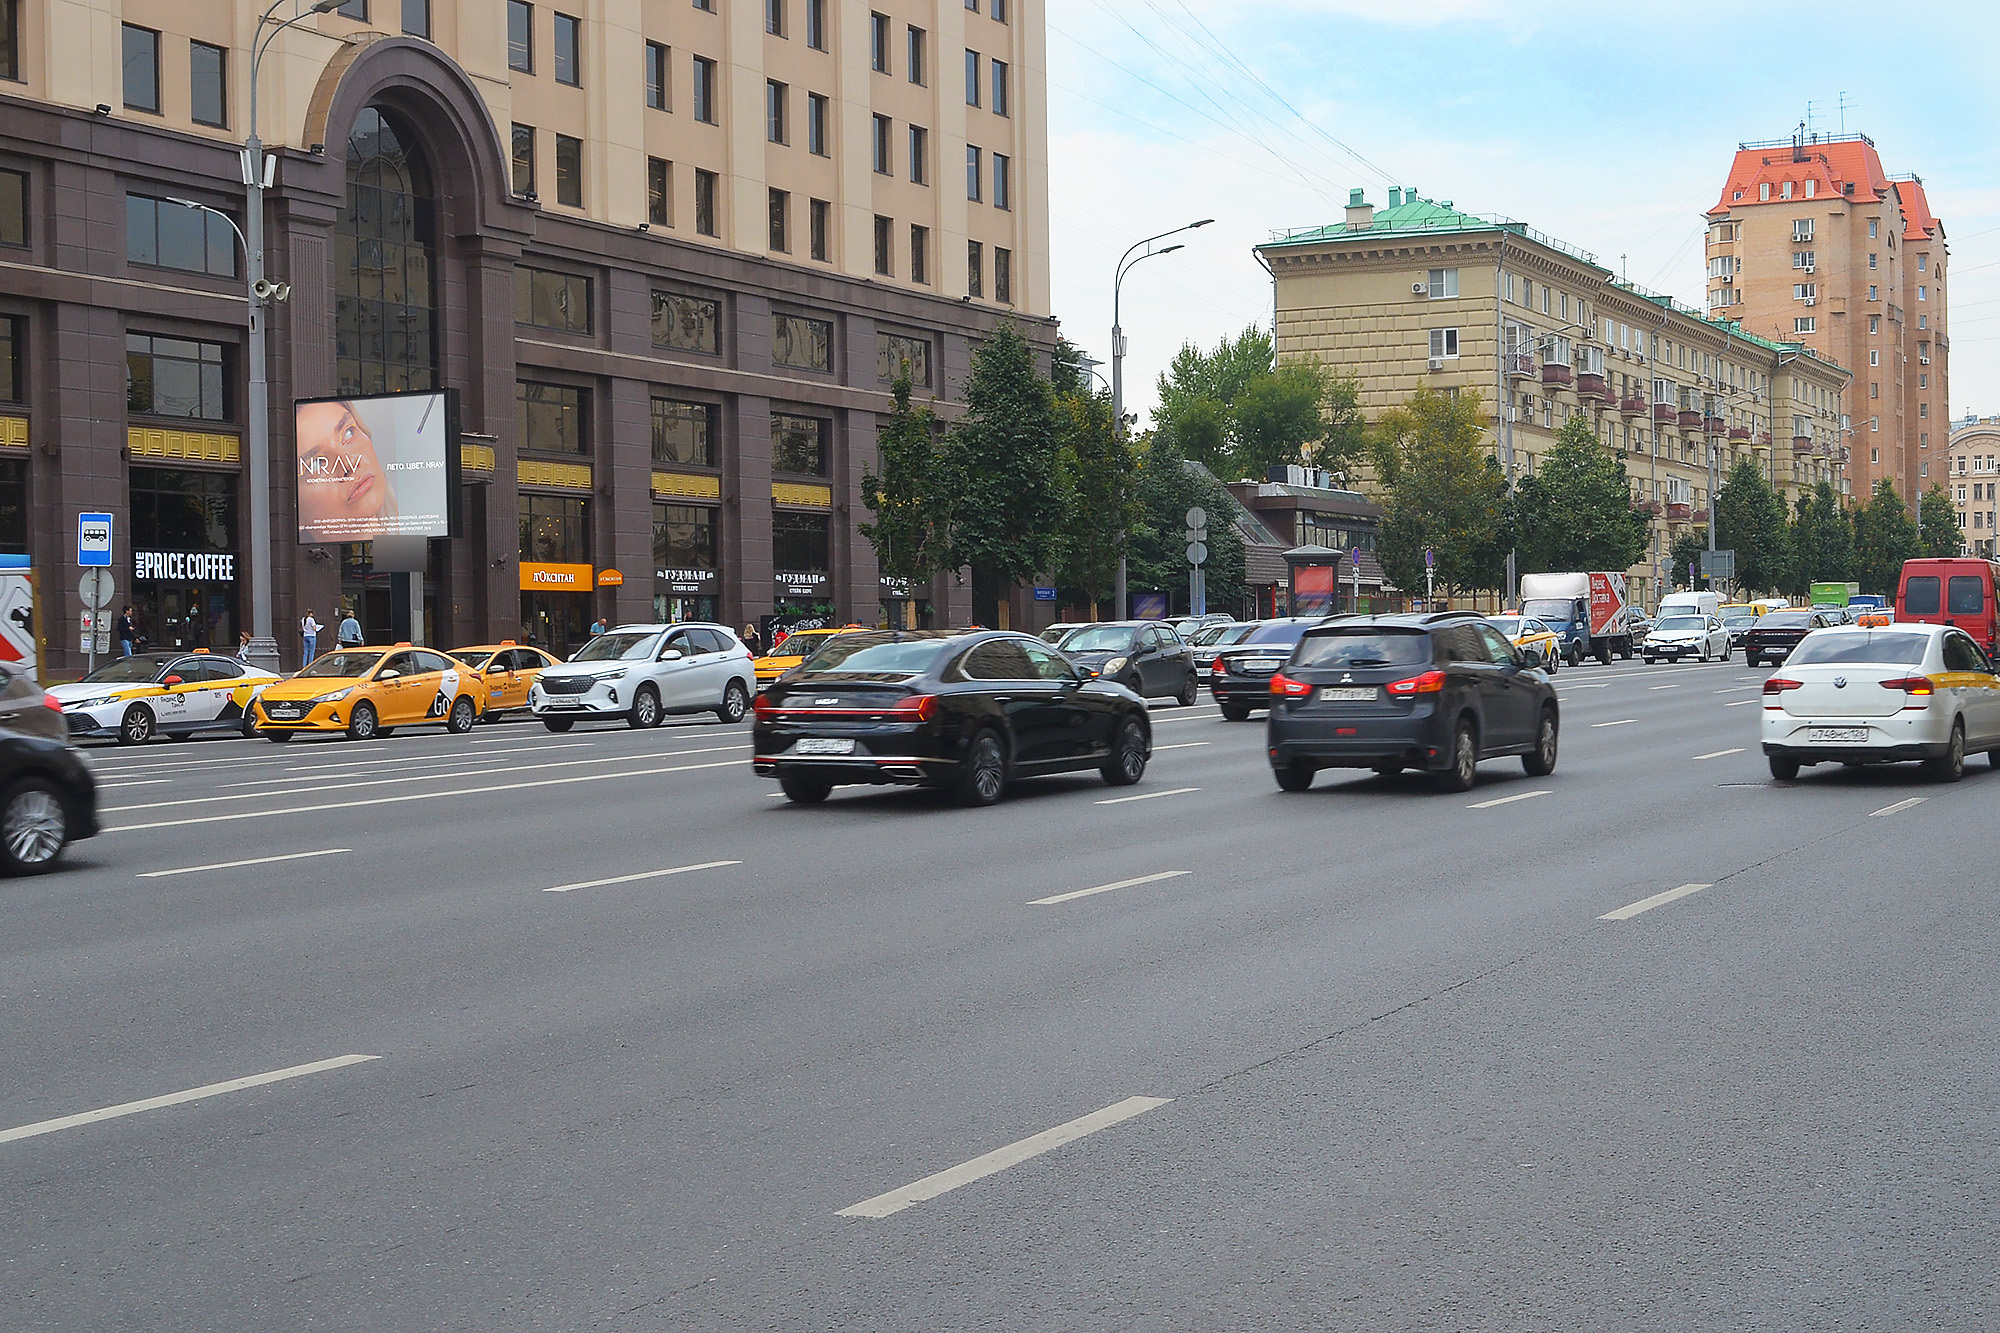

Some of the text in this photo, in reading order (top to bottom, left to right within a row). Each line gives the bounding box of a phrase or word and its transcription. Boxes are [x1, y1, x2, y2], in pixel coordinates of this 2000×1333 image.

[298, 454, 362, 476] NRAV
[386, 461, 445, 471] ЛЕТО. ЦВЕТ. NRAV
[135, 551, 234, 581] ONE PRICE COFFEE
[434, 692, 450, 716] Go
